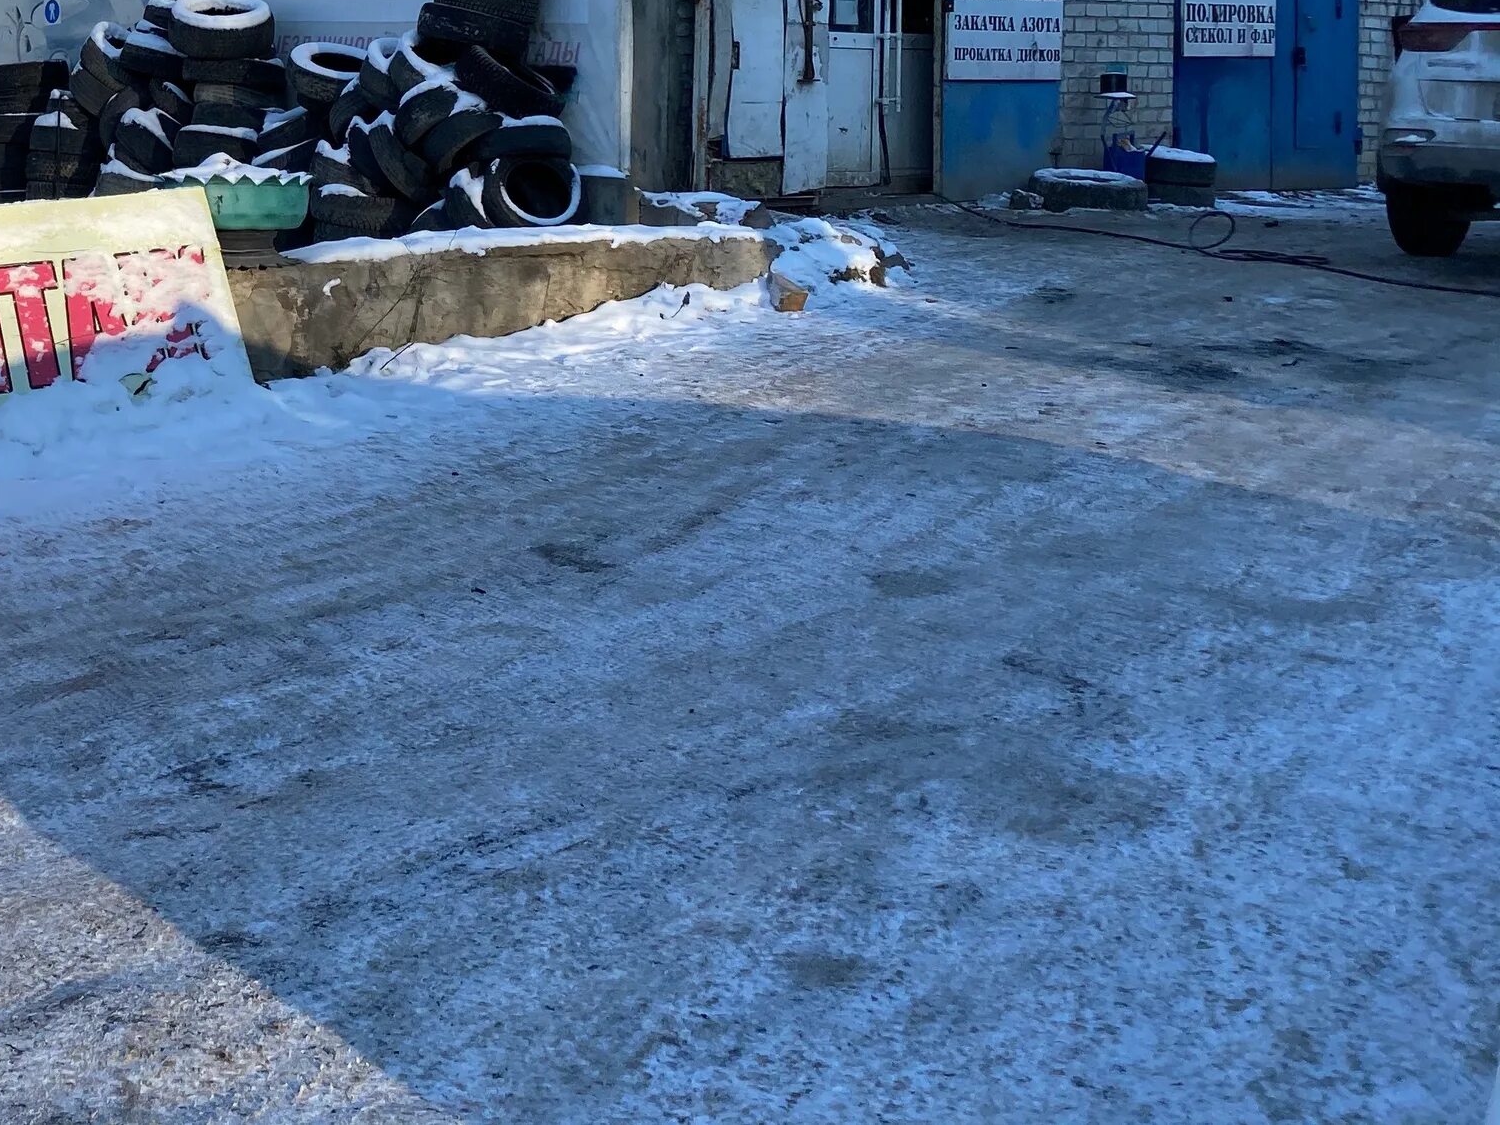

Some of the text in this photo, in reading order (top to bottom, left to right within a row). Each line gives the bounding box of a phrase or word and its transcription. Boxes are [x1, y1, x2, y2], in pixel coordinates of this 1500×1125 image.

[1186, 2, 1275, 24] ПОЛИРОВКА
[954, 14, 1061, 33] ЗАКАЧКА АЗОТА
[1185, 26, 1275, 45] СТЕКОЛ И ФАР
[954, 47, 1061, 63] ПРОКАТКА ДИСКОВ
